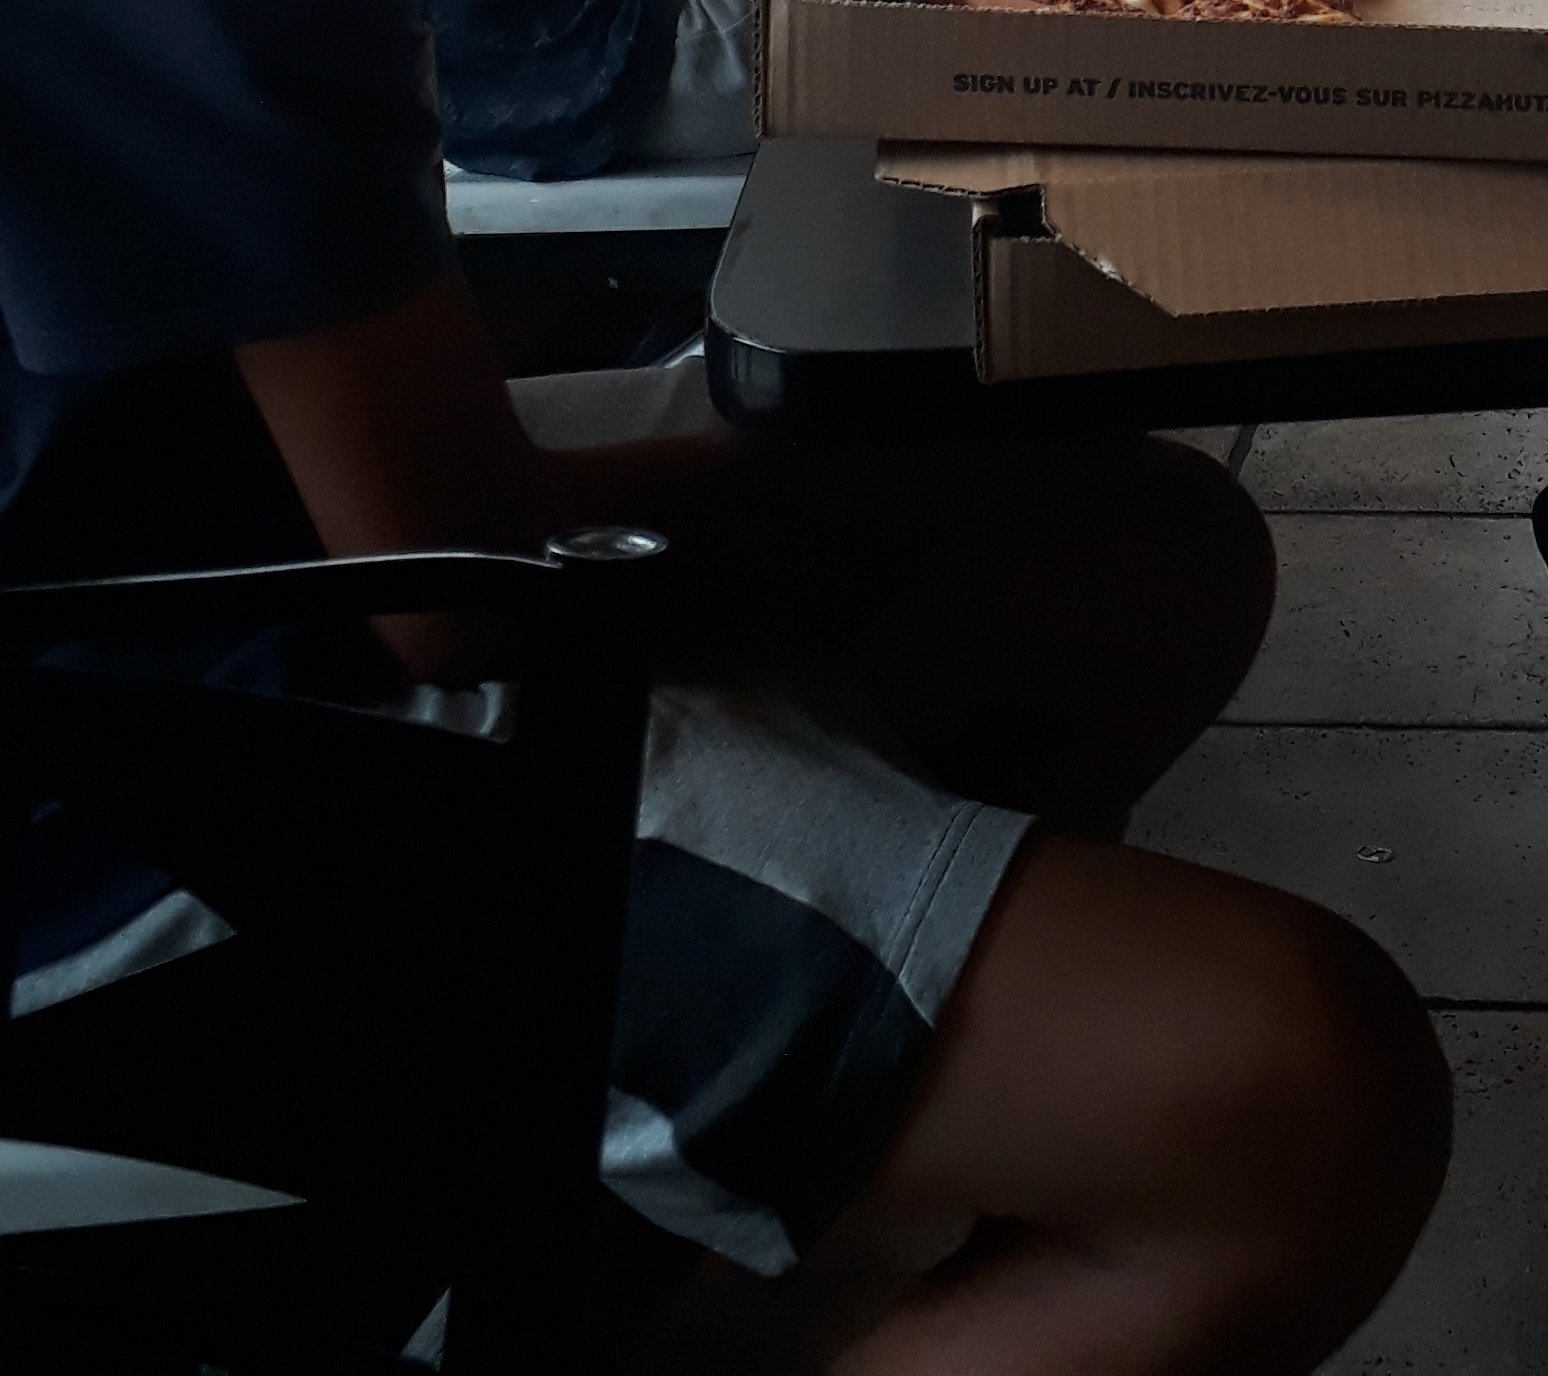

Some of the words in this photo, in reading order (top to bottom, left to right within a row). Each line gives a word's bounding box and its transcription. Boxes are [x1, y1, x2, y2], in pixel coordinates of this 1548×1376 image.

[952, 73, 1015, 94] SIGN
[1022, 76, 1058, 95] UP
[1065, 77, 1101, 97] AT
[1127, 79, 1347, 106] INSCRIVEZ-VOUS
[1356, 87, 1408, 108] SUR
